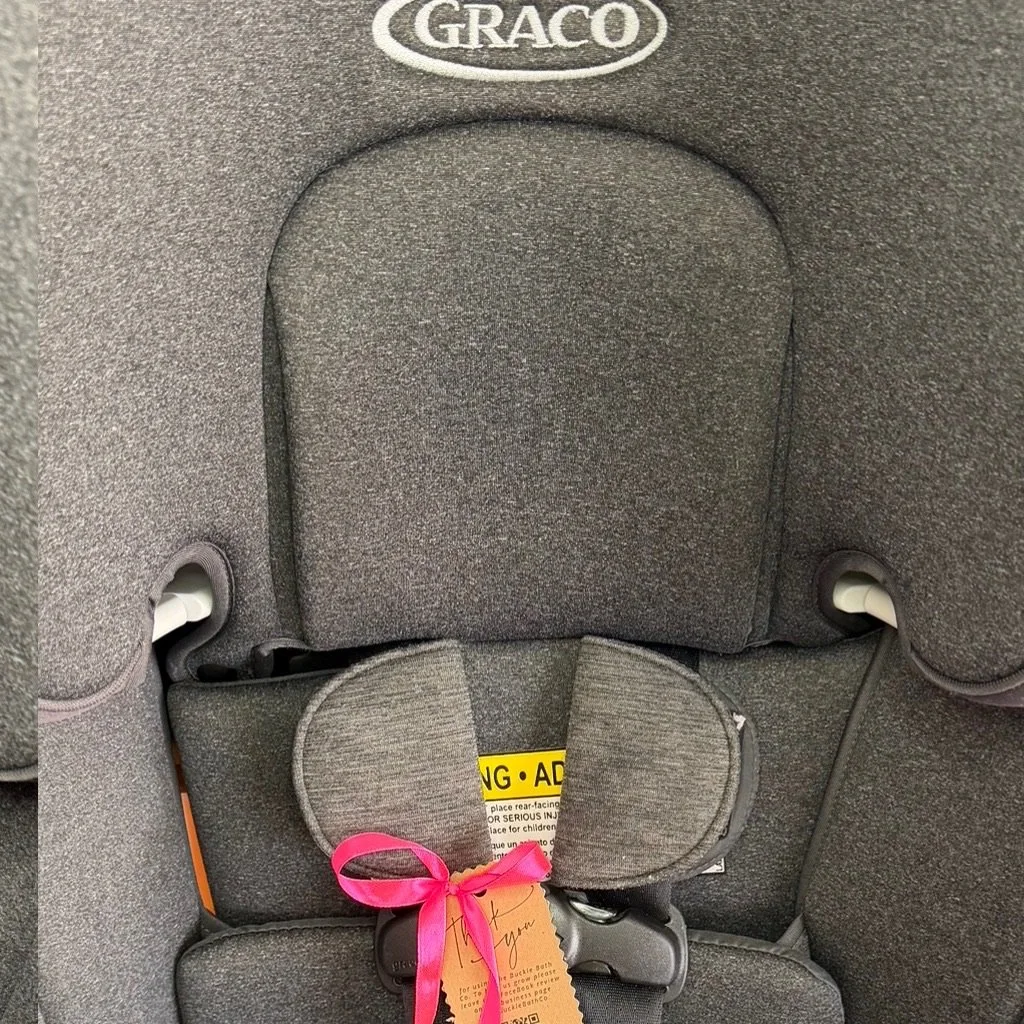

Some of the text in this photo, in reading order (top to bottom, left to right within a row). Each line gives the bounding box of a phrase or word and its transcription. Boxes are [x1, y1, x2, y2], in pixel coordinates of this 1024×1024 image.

[414, 0, 640, 49] GRACO
[491, 804, 512, 813] place
[487, 815, 501, 824] OR
[503, 812, 541, 822] SERIOUS
[490, 823, 556, 834] lace for children
[533, 969, 556, 981] please
[472, 981, 489, 990] usin
